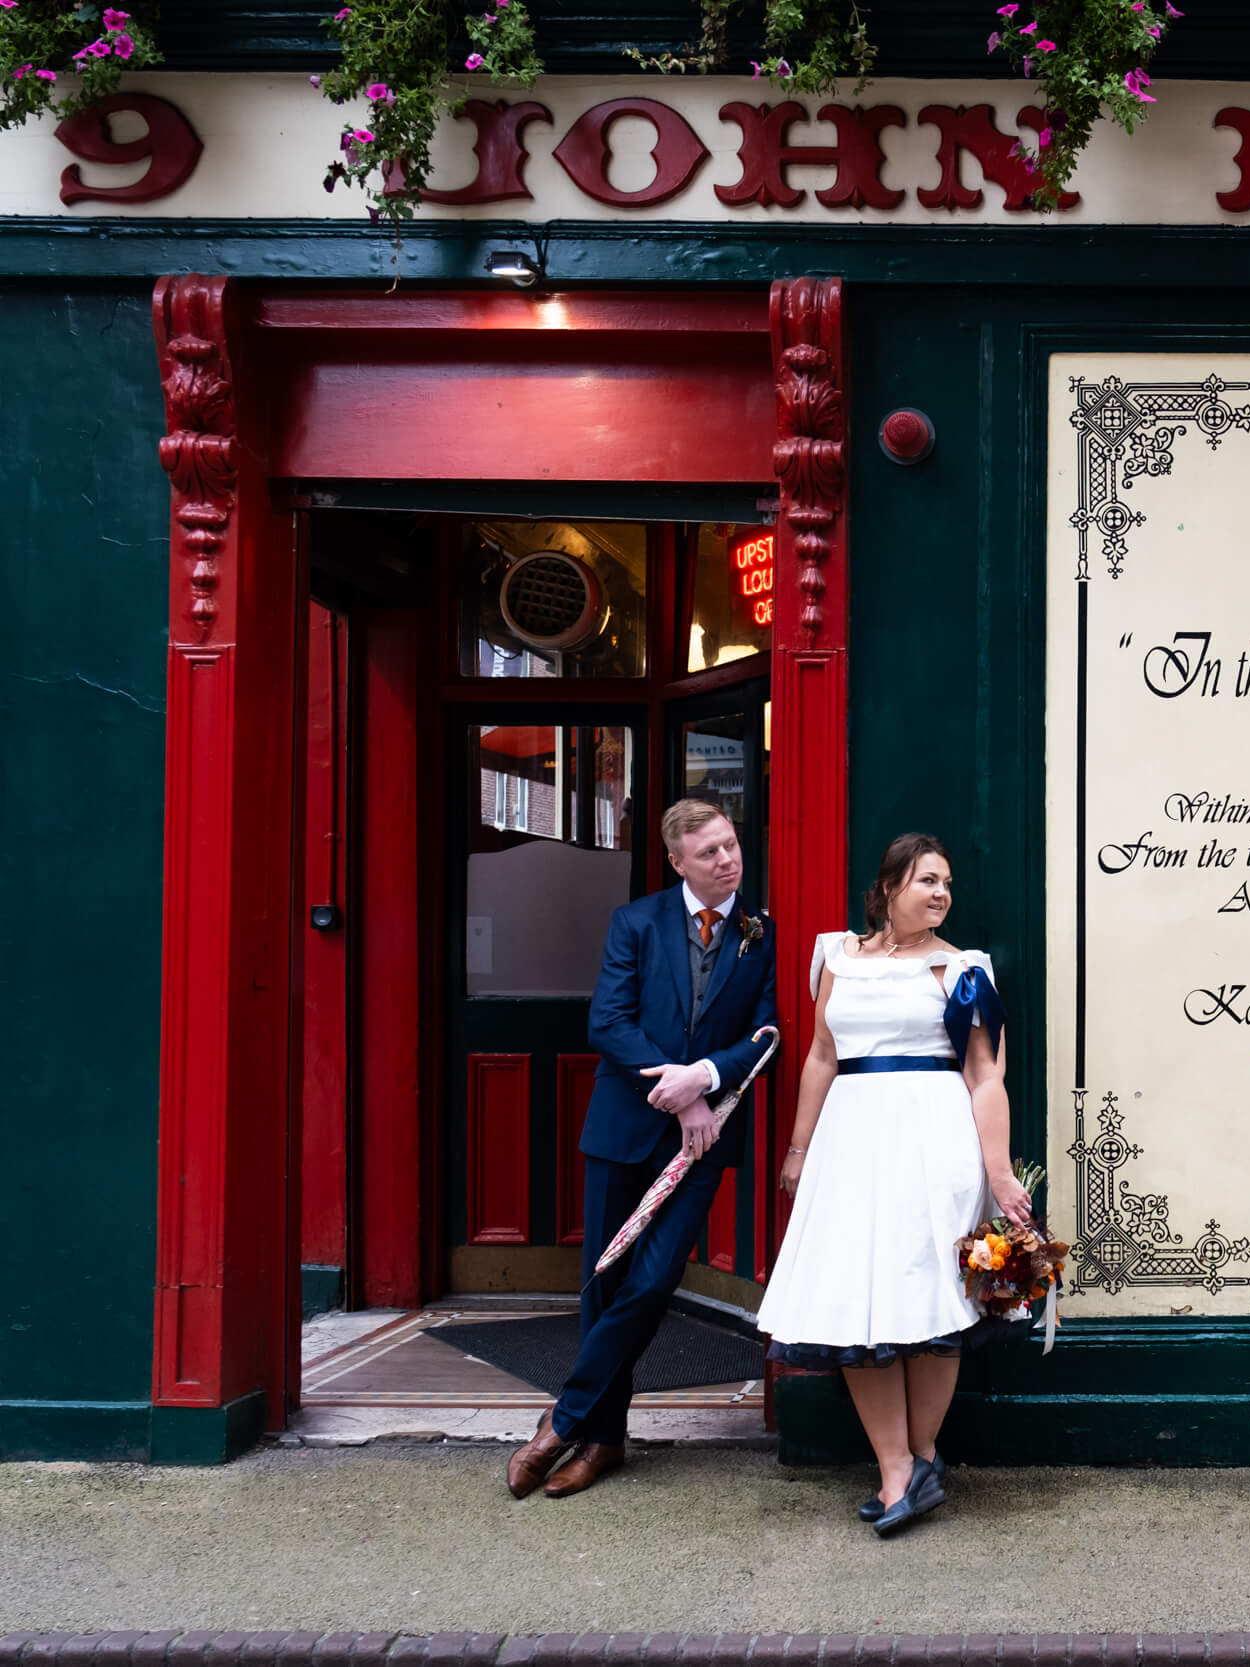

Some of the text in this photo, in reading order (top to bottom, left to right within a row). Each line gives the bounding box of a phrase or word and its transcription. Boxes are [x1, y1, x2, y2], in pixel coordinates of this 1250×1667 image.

[54, 91, 204, 207] 9
[383, 97, 1083, 212] JOHN
[1143, 631, 1222, 699] In
[1097, 831, 1188, 875] From
[1197, 838, 1237, 869] the
